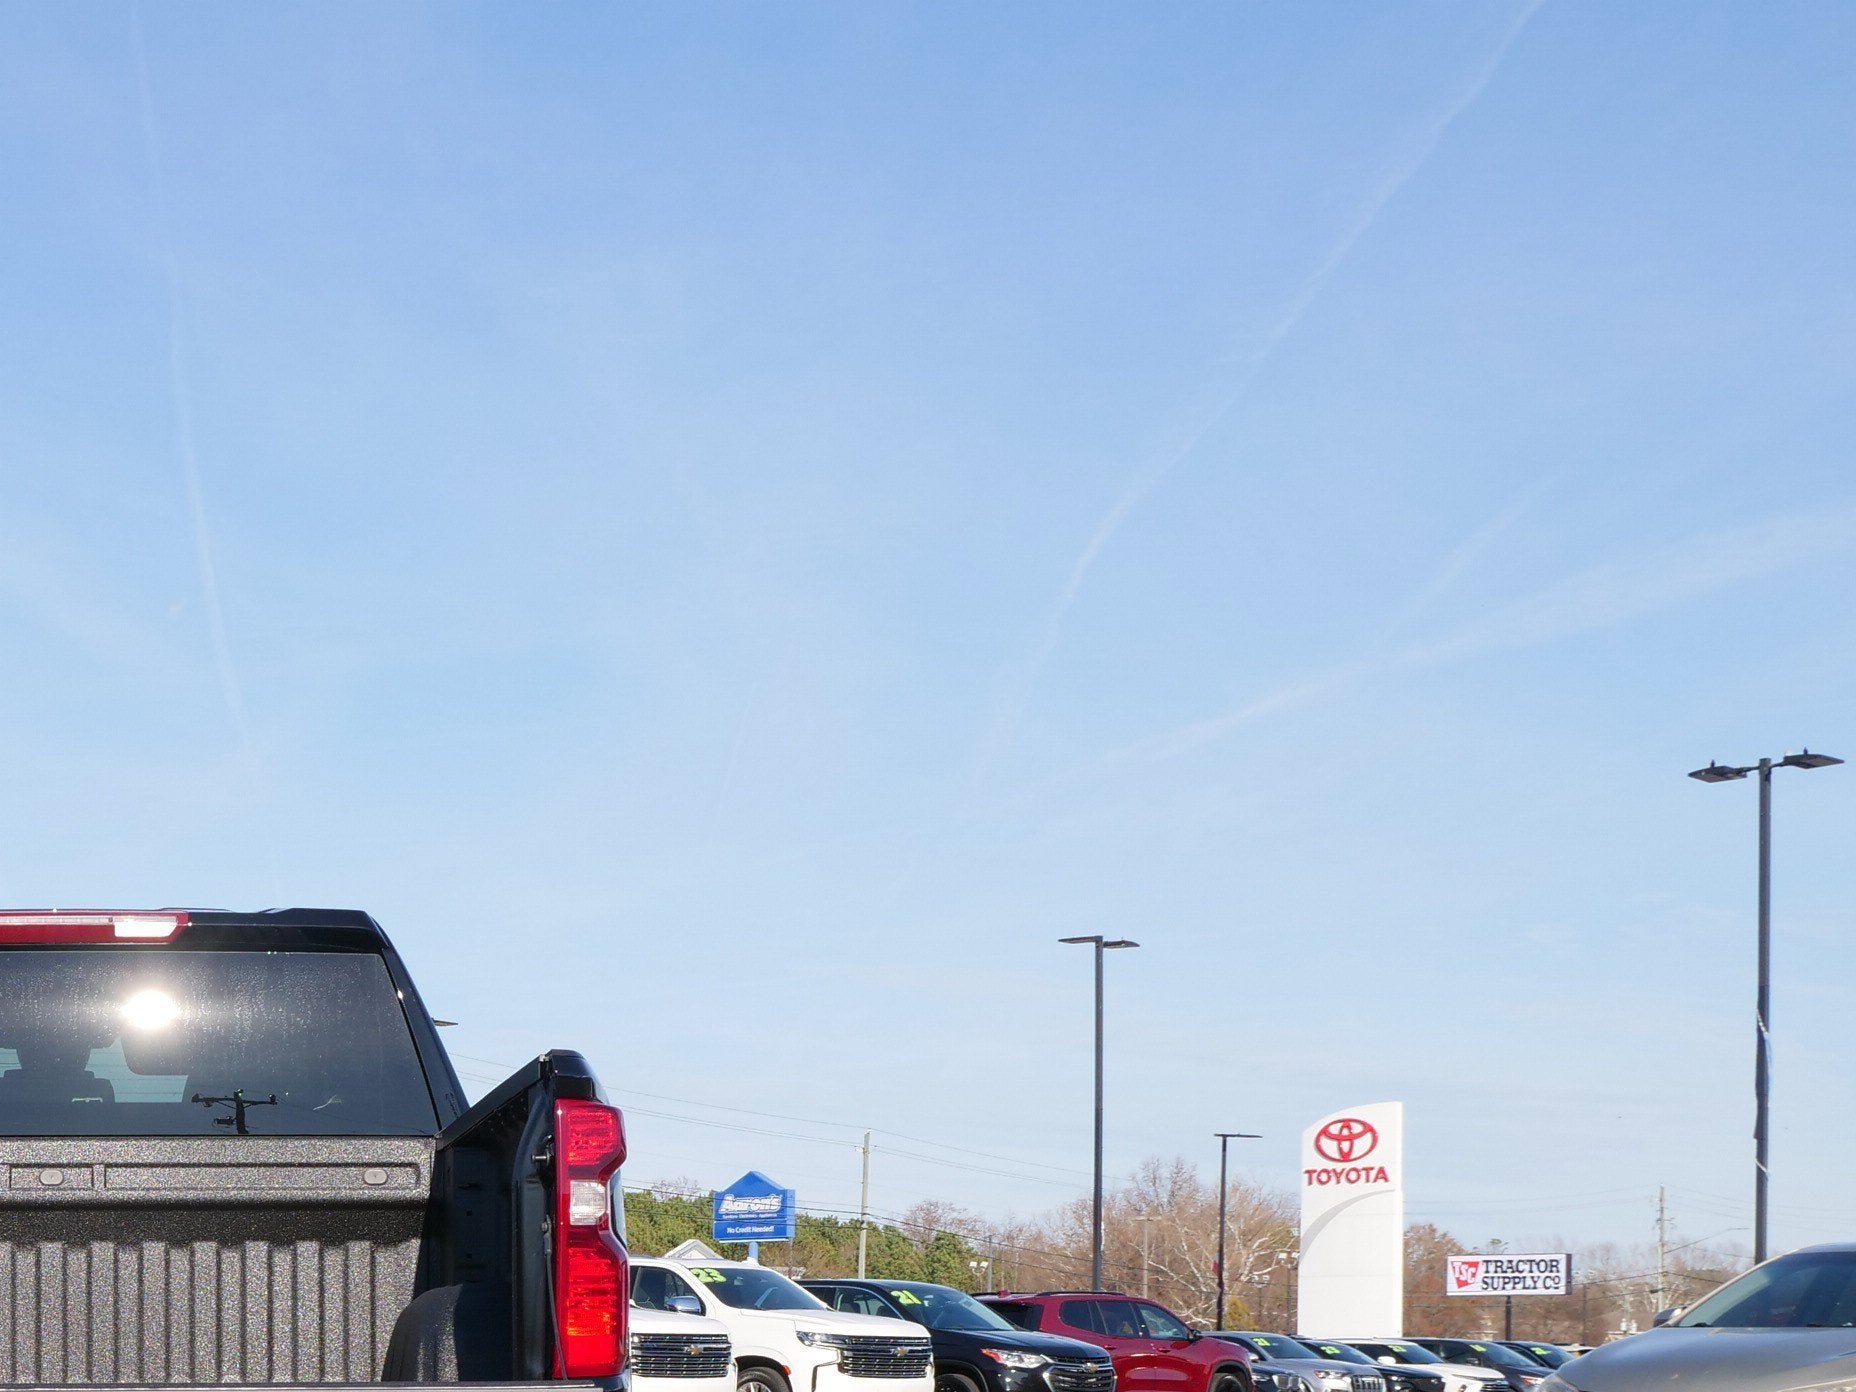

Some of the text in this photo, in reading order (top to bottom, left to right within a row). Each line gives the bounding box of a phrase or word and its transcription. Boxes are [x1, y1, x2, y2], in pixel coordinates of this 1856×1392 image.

[1303, 1166, 1390, 1186] TOYOTA
[718, 1194, 783, 1214] Aaron's
[1451, 1261, 1477, 1284] TSC
[1481, 1259, 1560, 1274] TRACTOR
[690, 1268, 727, 1283] 23
[1481, 1276, 1540, 1290] SUPPLY
[890, 1290, 922, 1305] 21
